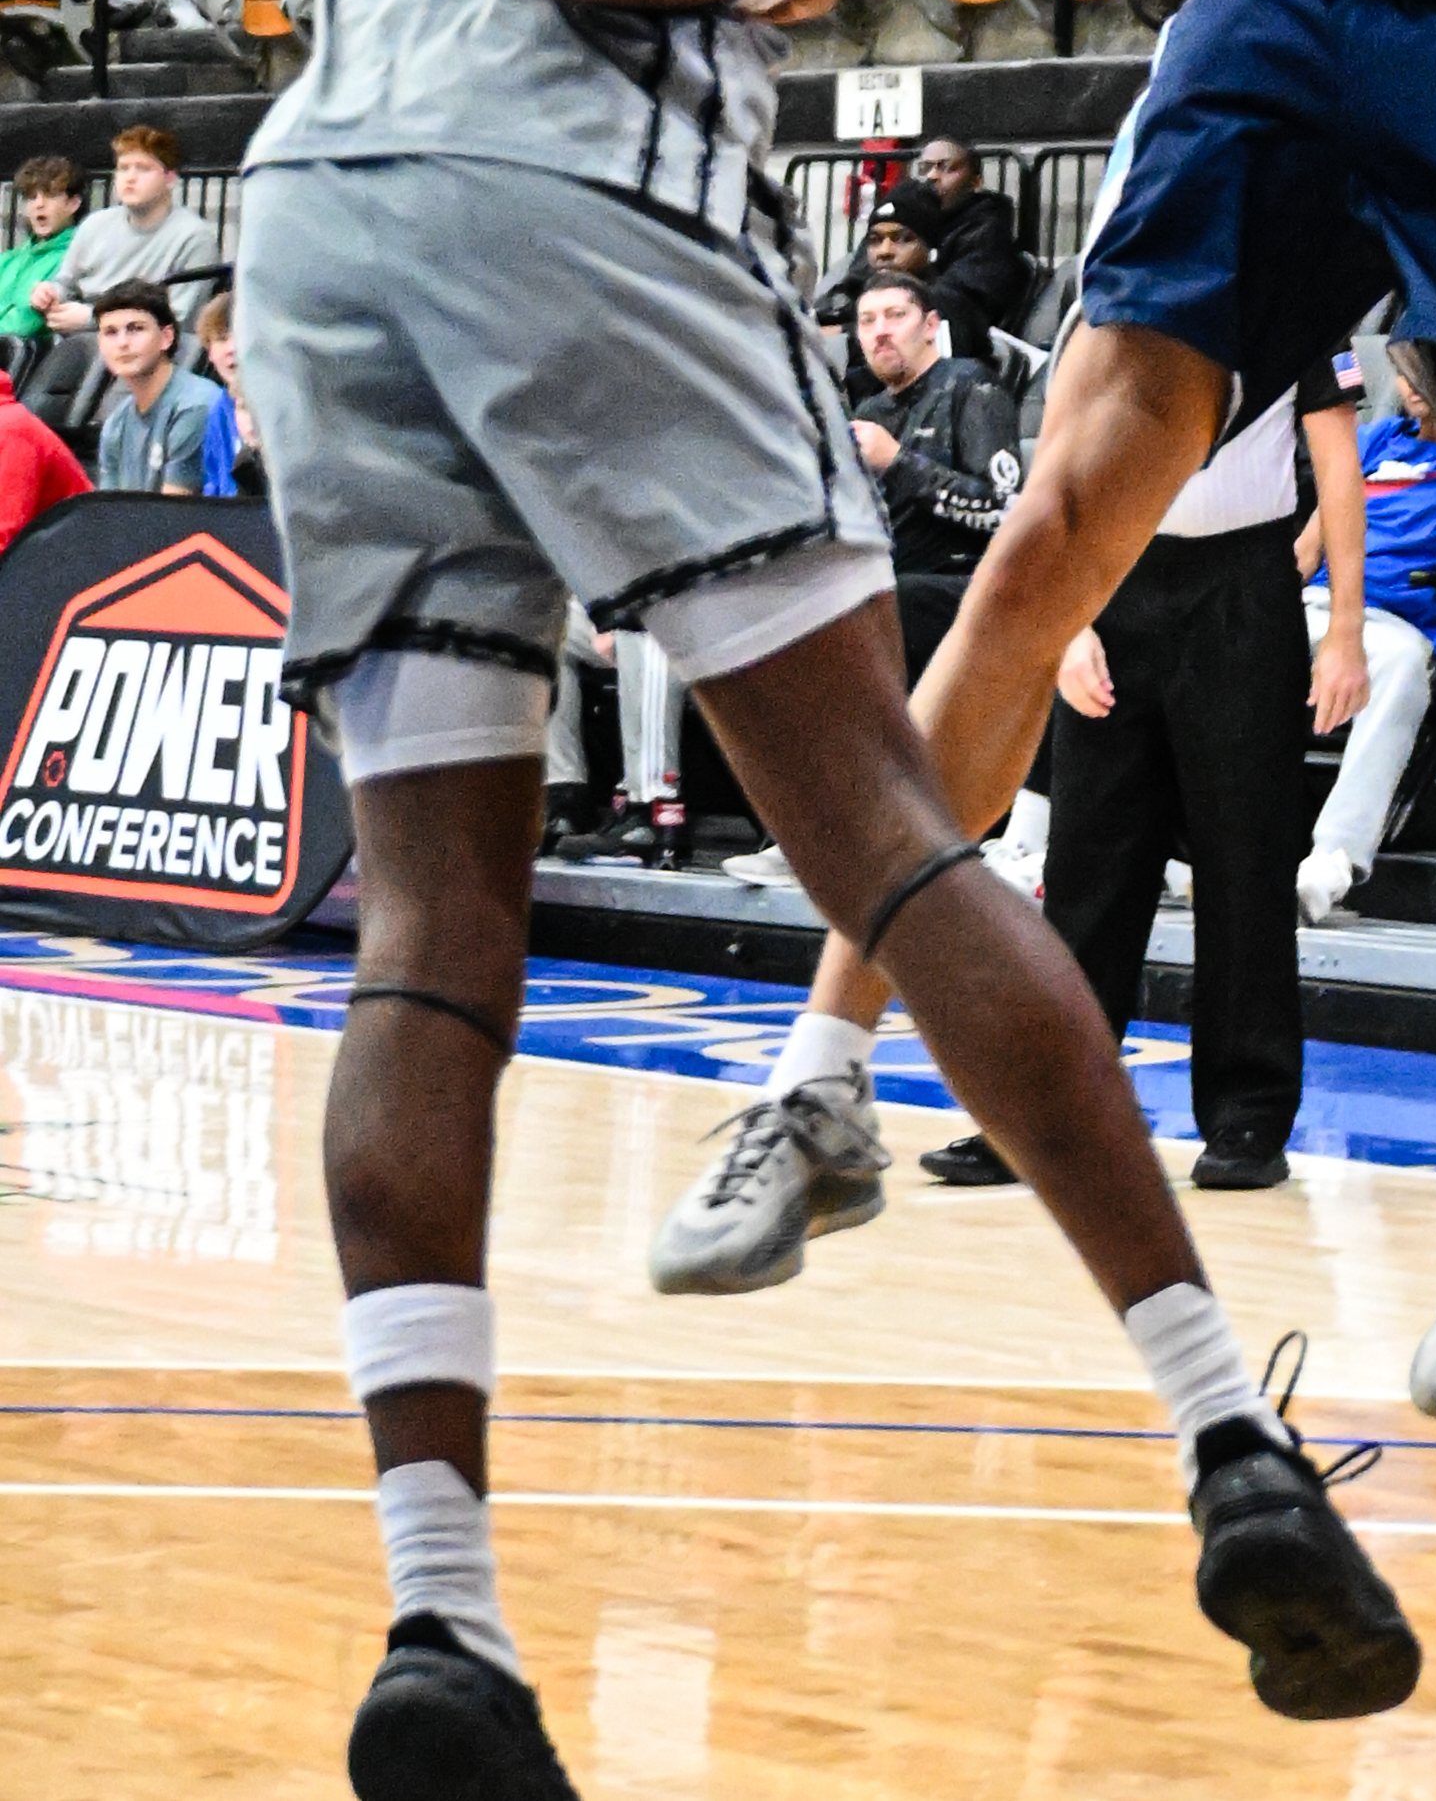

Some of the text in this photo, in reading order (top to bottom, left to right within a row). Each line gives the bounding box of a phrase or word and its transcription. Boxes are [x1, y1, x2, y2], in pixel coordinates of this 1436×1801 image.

[872, 99, 885, 137] A
[13, 636, 291, 812] POWER
[0, 798, 286, 887] CONFERENCE
